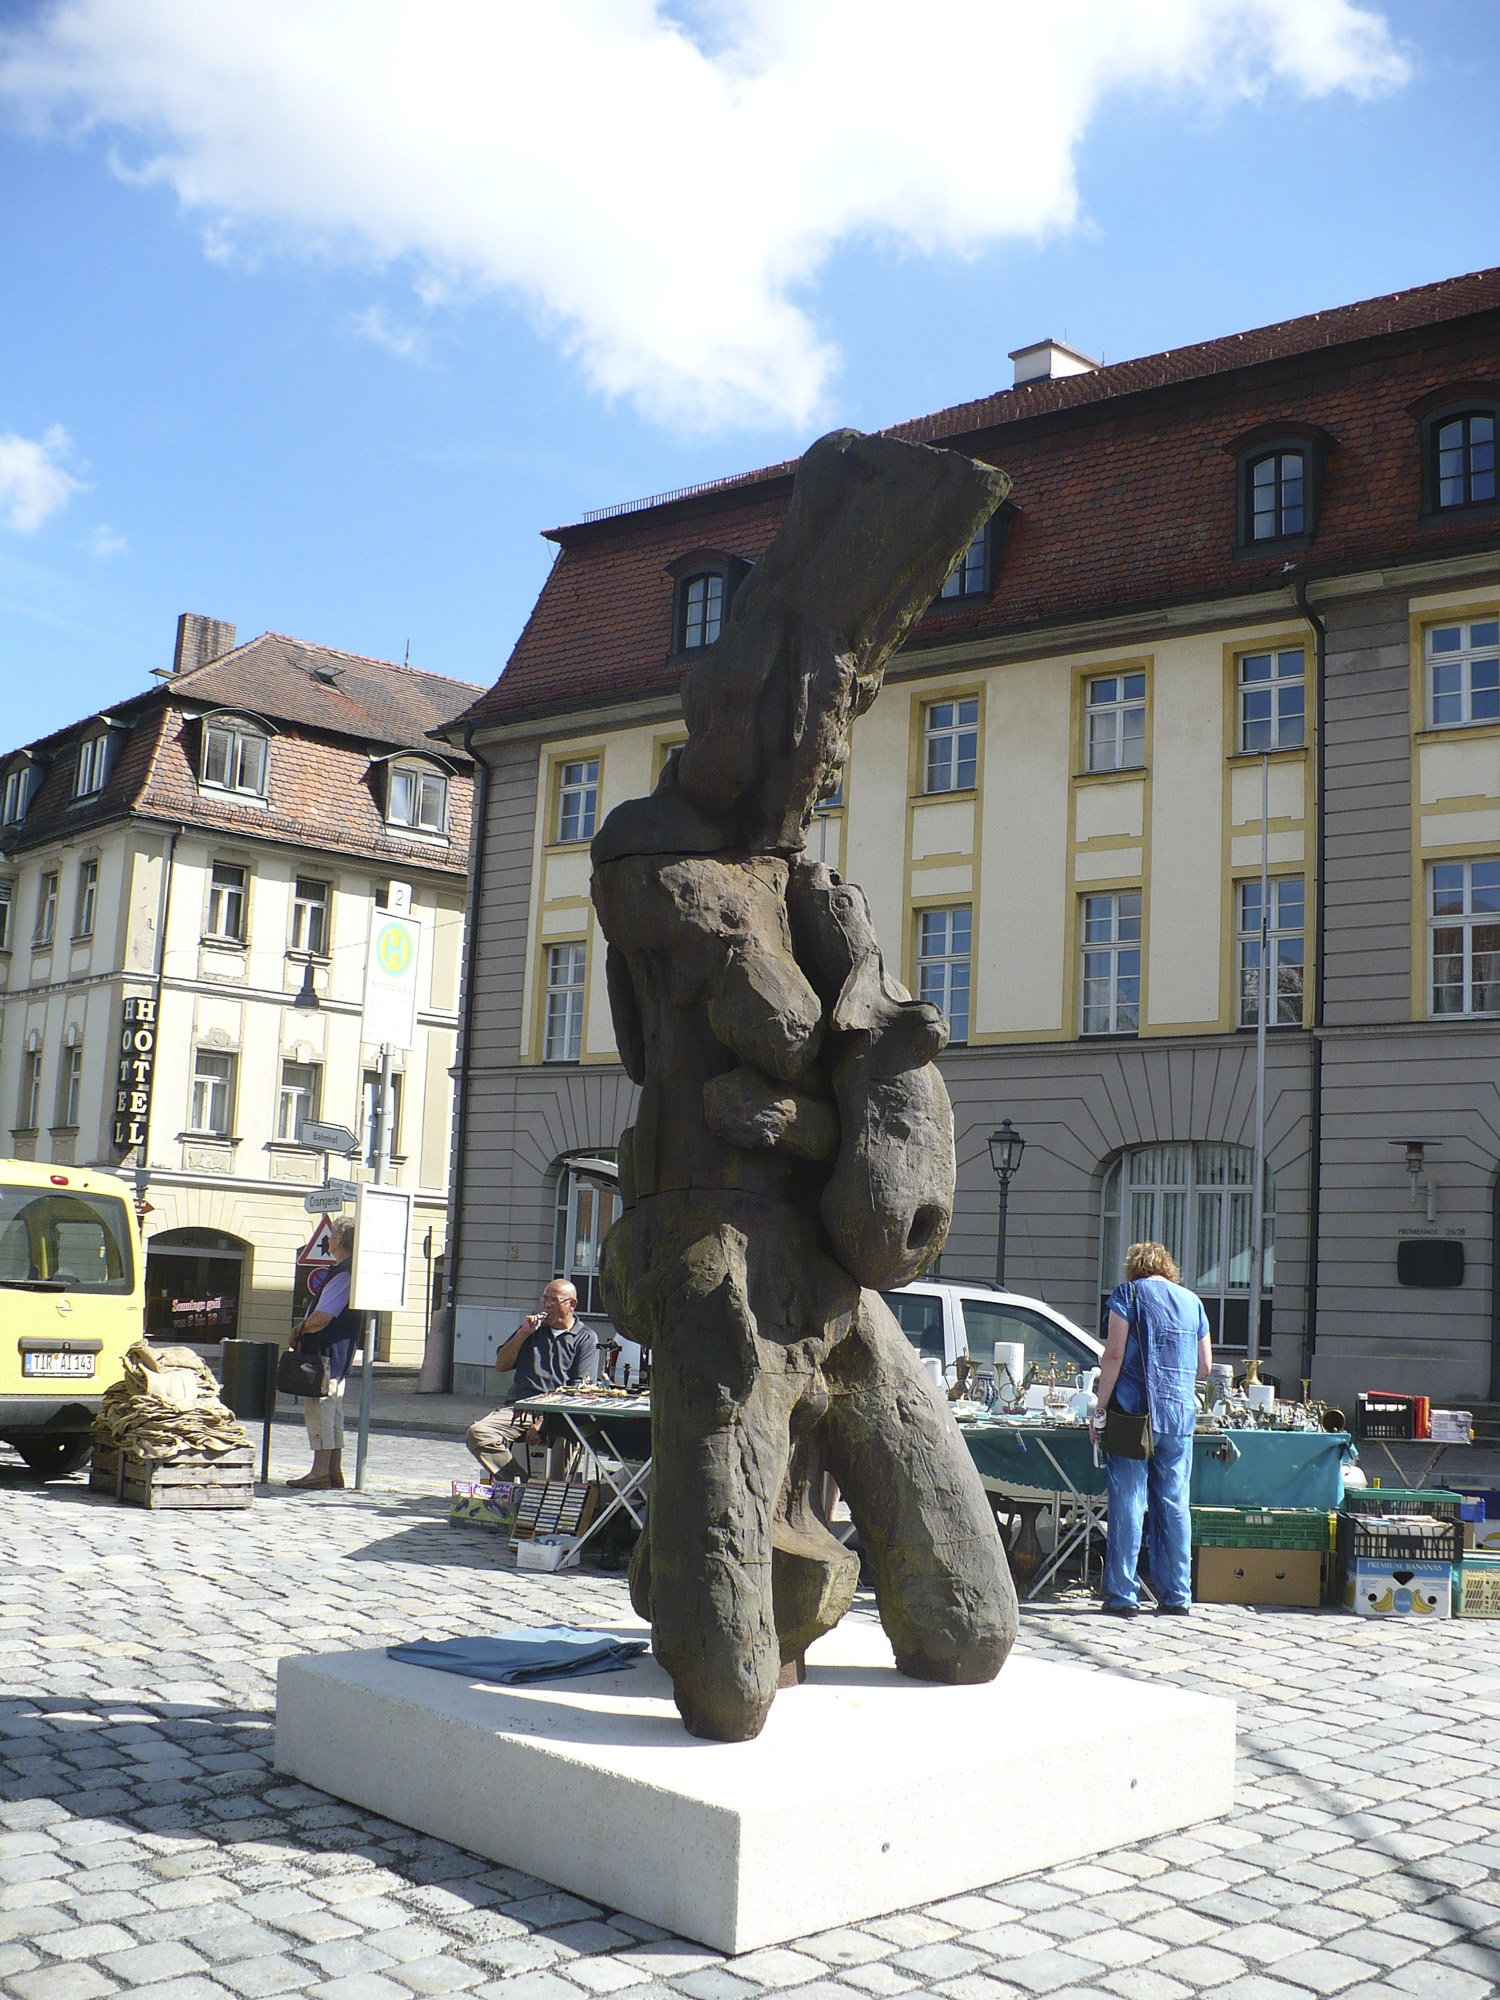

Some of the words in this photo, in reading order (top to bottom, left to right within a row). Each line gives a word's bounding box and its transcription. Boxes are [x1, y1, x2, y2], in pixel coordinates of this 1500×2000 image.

[395, 889, 404, 907] 2
[114, 1000, 135, 1144] HOTEL
[128, 1000, 157, 1145] HOTEL
[313, 1131, 339, 1145] Bahnhof
[309, 1196, 340, 1209] Orangerie
[1398, 1228, 1438, 1236] PROMENADE
[34, 1355, 52, 1370] TIR
[74, 1356, 92, 1370] 143
[1367, 1561, 1403, 1570] PREMIUM
[1406, 1563, 1443, 1572] BANANAS
